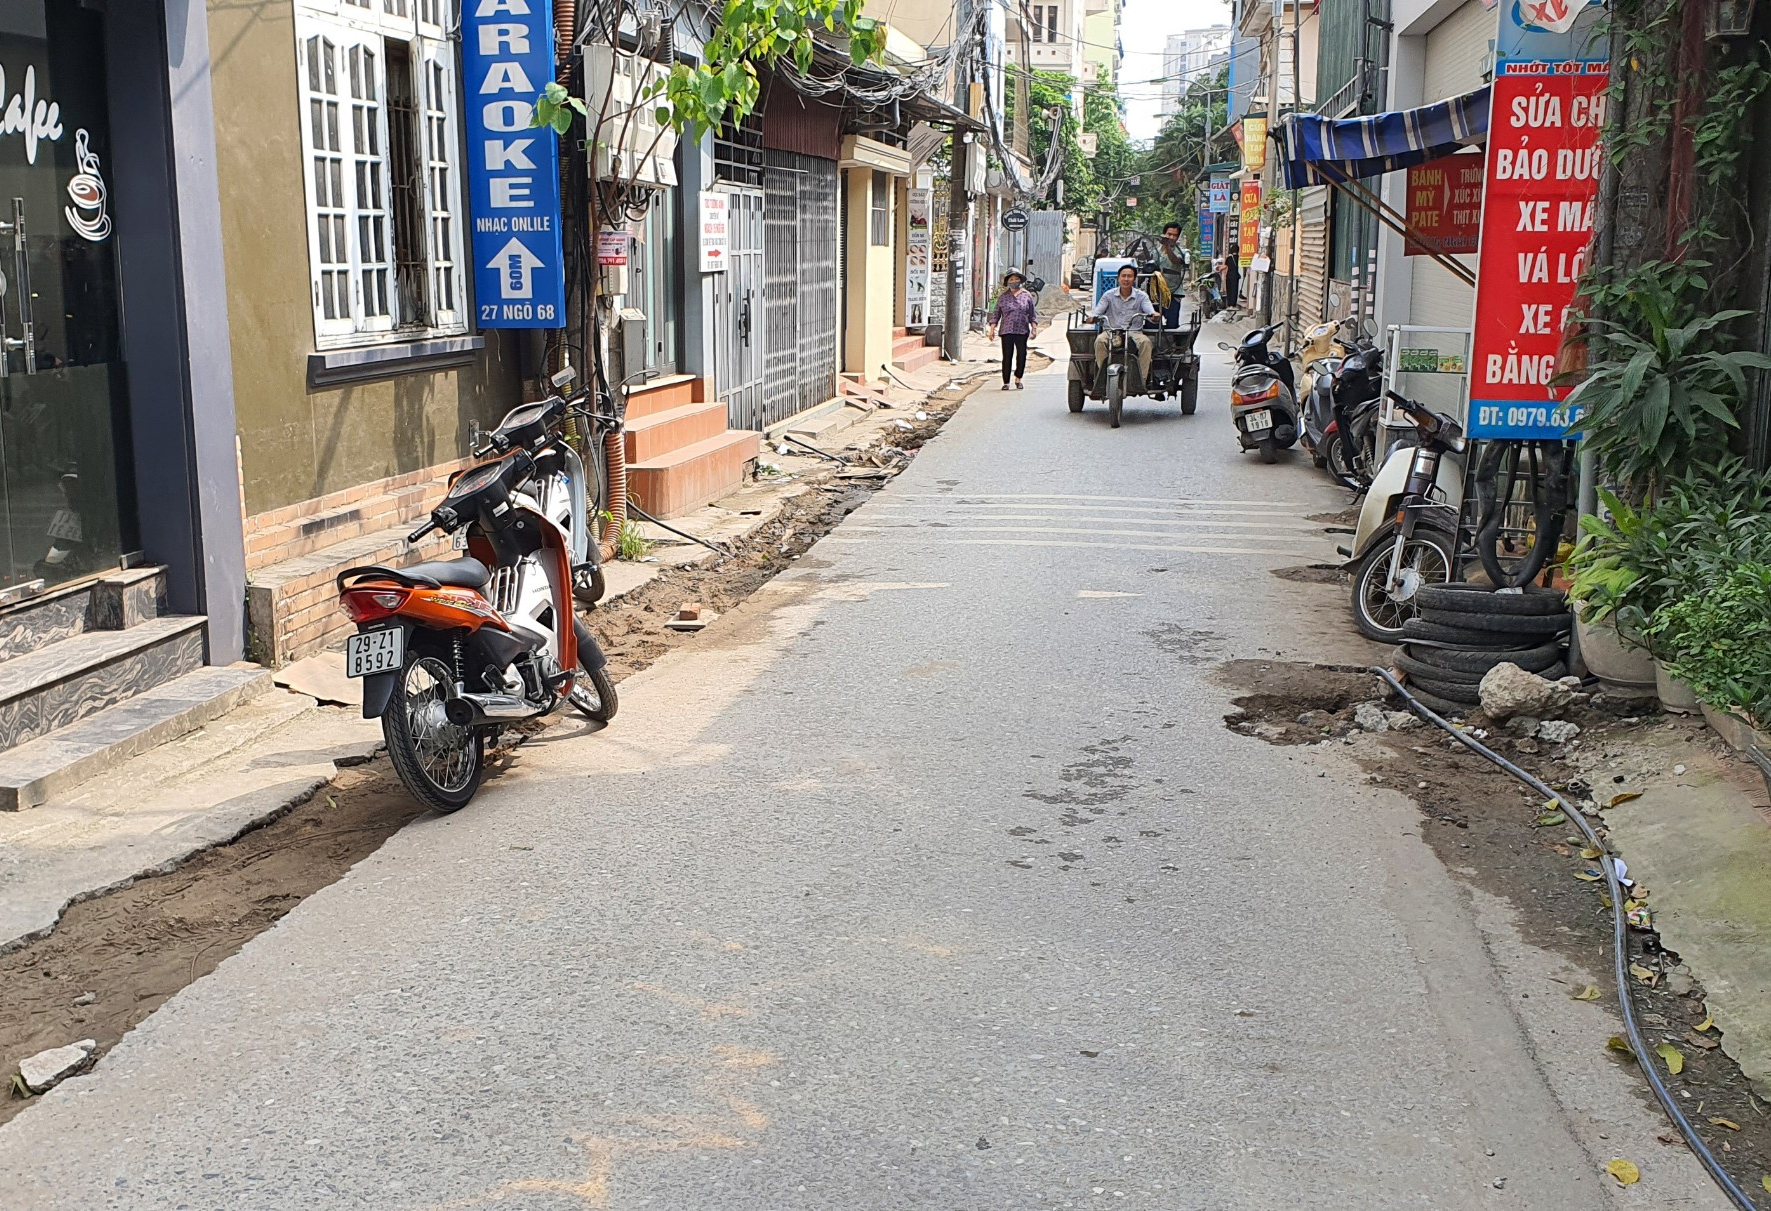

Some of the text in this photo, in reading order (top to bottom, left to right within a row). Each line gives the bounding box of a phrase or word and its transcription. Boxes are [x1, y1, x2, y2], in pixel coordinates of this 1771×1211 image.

[1505, 60, 1549, 75] NHỚT
[1553, 59, 1583, 75] TỐT
[1510, 82, 1562, 128] SỬA
[1496, 135, 1549, 180] BẢO
[1411, 166, 1442, 186] BÁNH
[1213, 191, 1226, 201] LÀ
[1453, 185, 1471, 204] XÚC
[476, 216, 551, 235] NHẠC ONLILE
[1411, 211, 1440, 228] PATE
[1453, 209, 1471, 228] THỊT
[1516, 201, 1550, 232] XE
[508, 254, 524, 291] 60M
[1517, 245, 1549, 284] VÁ
[481, 302, 555, 320] 27 NGÕ 68
[1519, 304, 1553, 334] XE
[1485, 340, 1555, 385] BẰNG
[1478, 406, 1503, 426] ĐT:
[355, 630, 394, 654] 29-Z1
[355, 650, 394, 673] 8592
